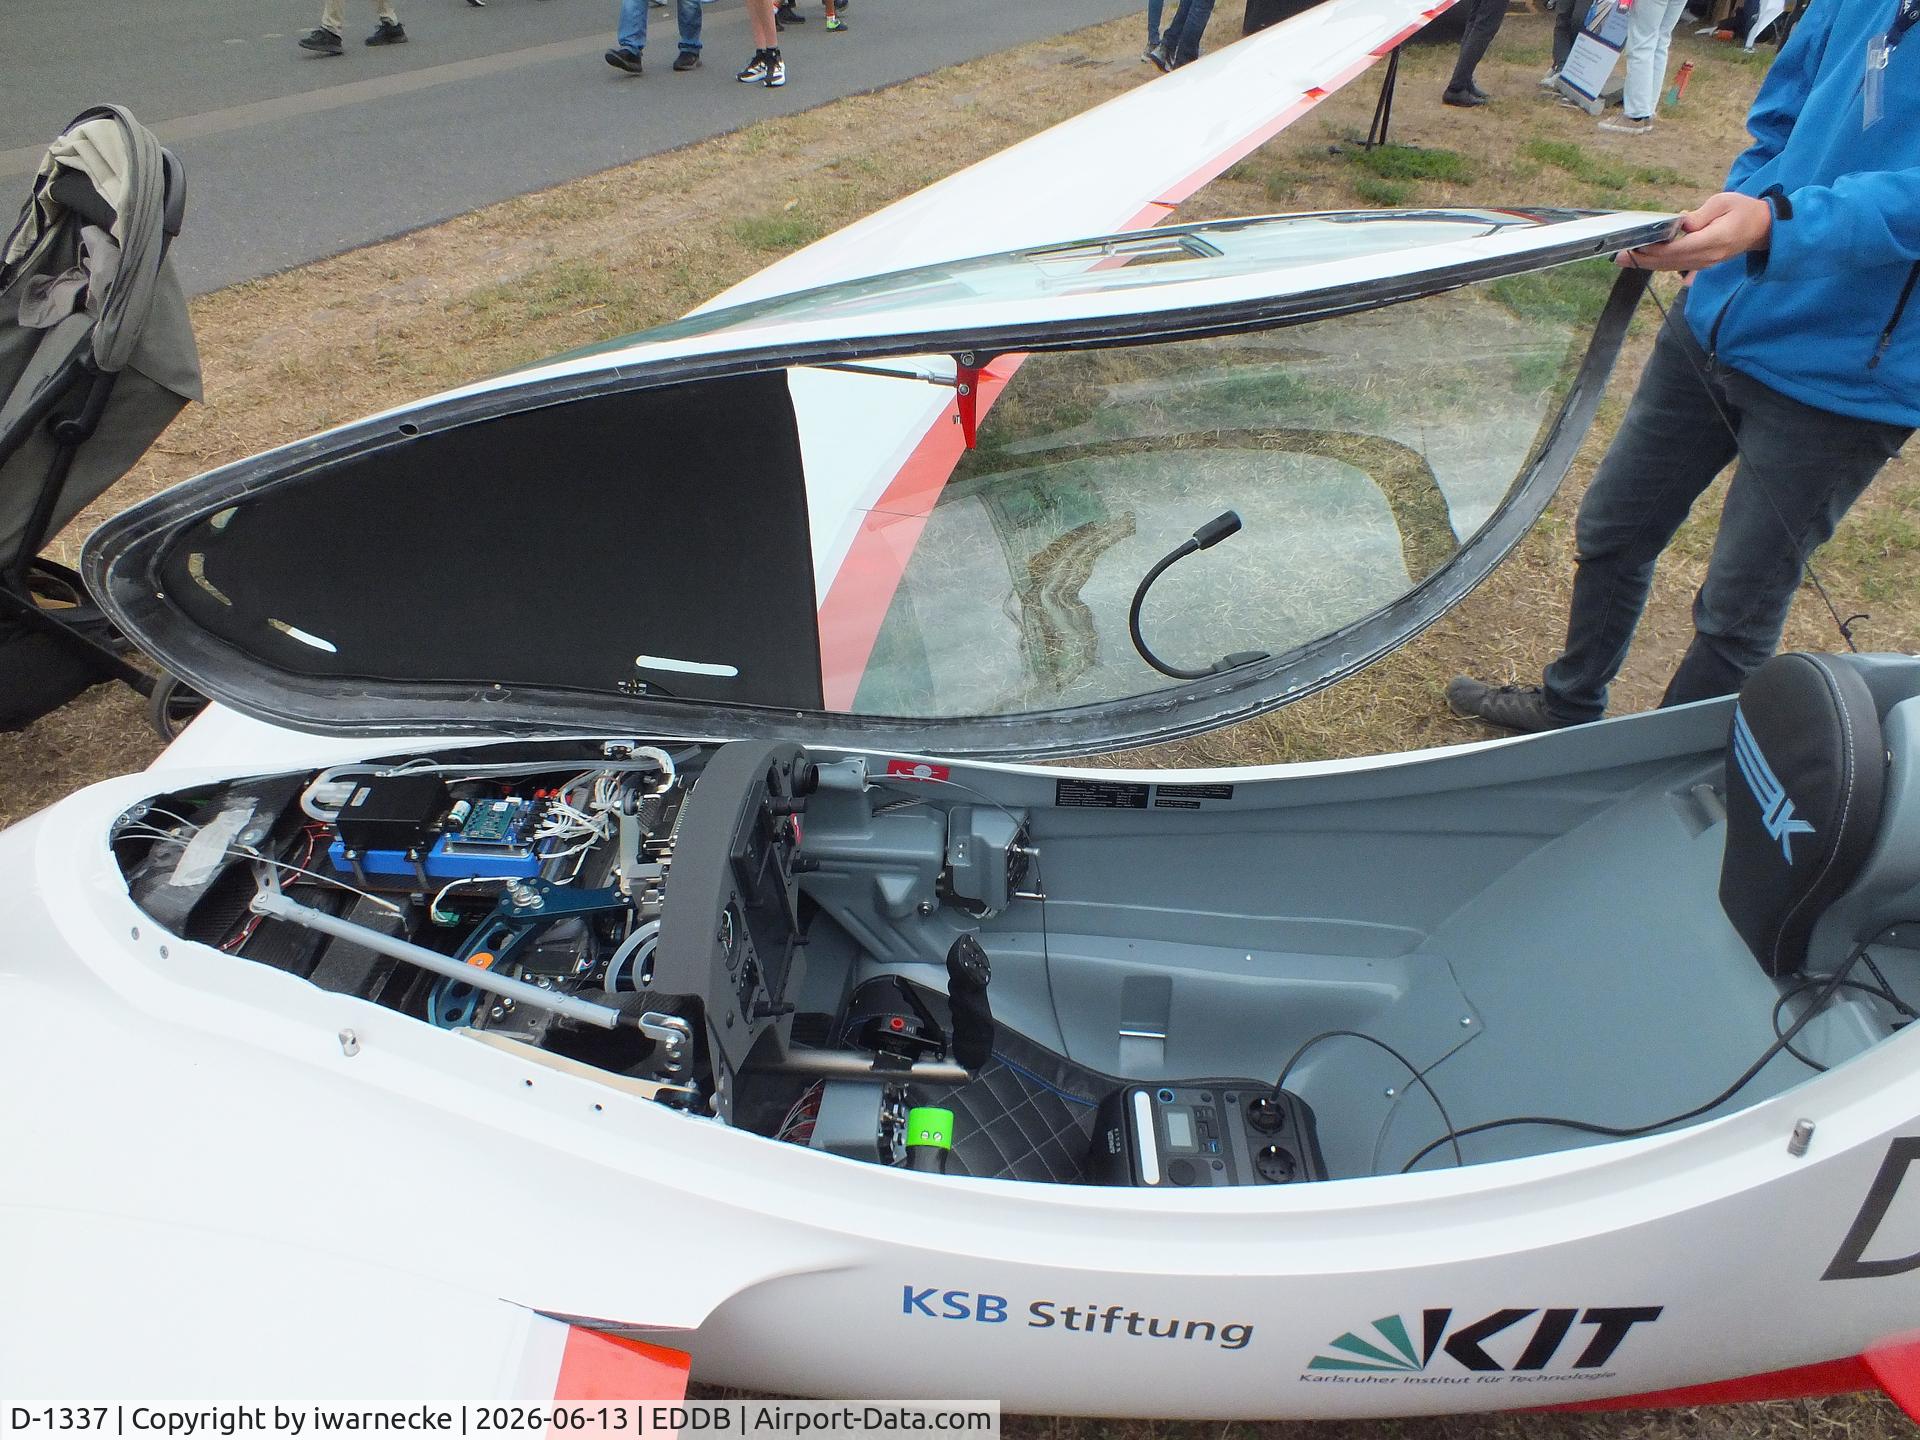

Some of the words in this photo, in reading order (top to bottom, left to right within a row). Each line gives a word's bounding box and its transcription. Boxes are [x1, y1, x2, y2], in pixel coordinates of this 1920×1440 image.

[903, 1285, 1008, 1323] KSB
[1028, 1300, 1254, 1350] Stiftung
[1422, 1305, 1664, 1372] KIT
[1300, 1373, 1399, 1384] Karlsruher
[1403, 1375, 1469, 1385] Institut
[1476, 1375, 1501, 1384] für
[1509, 1372, 1616, 1383] Technologie
